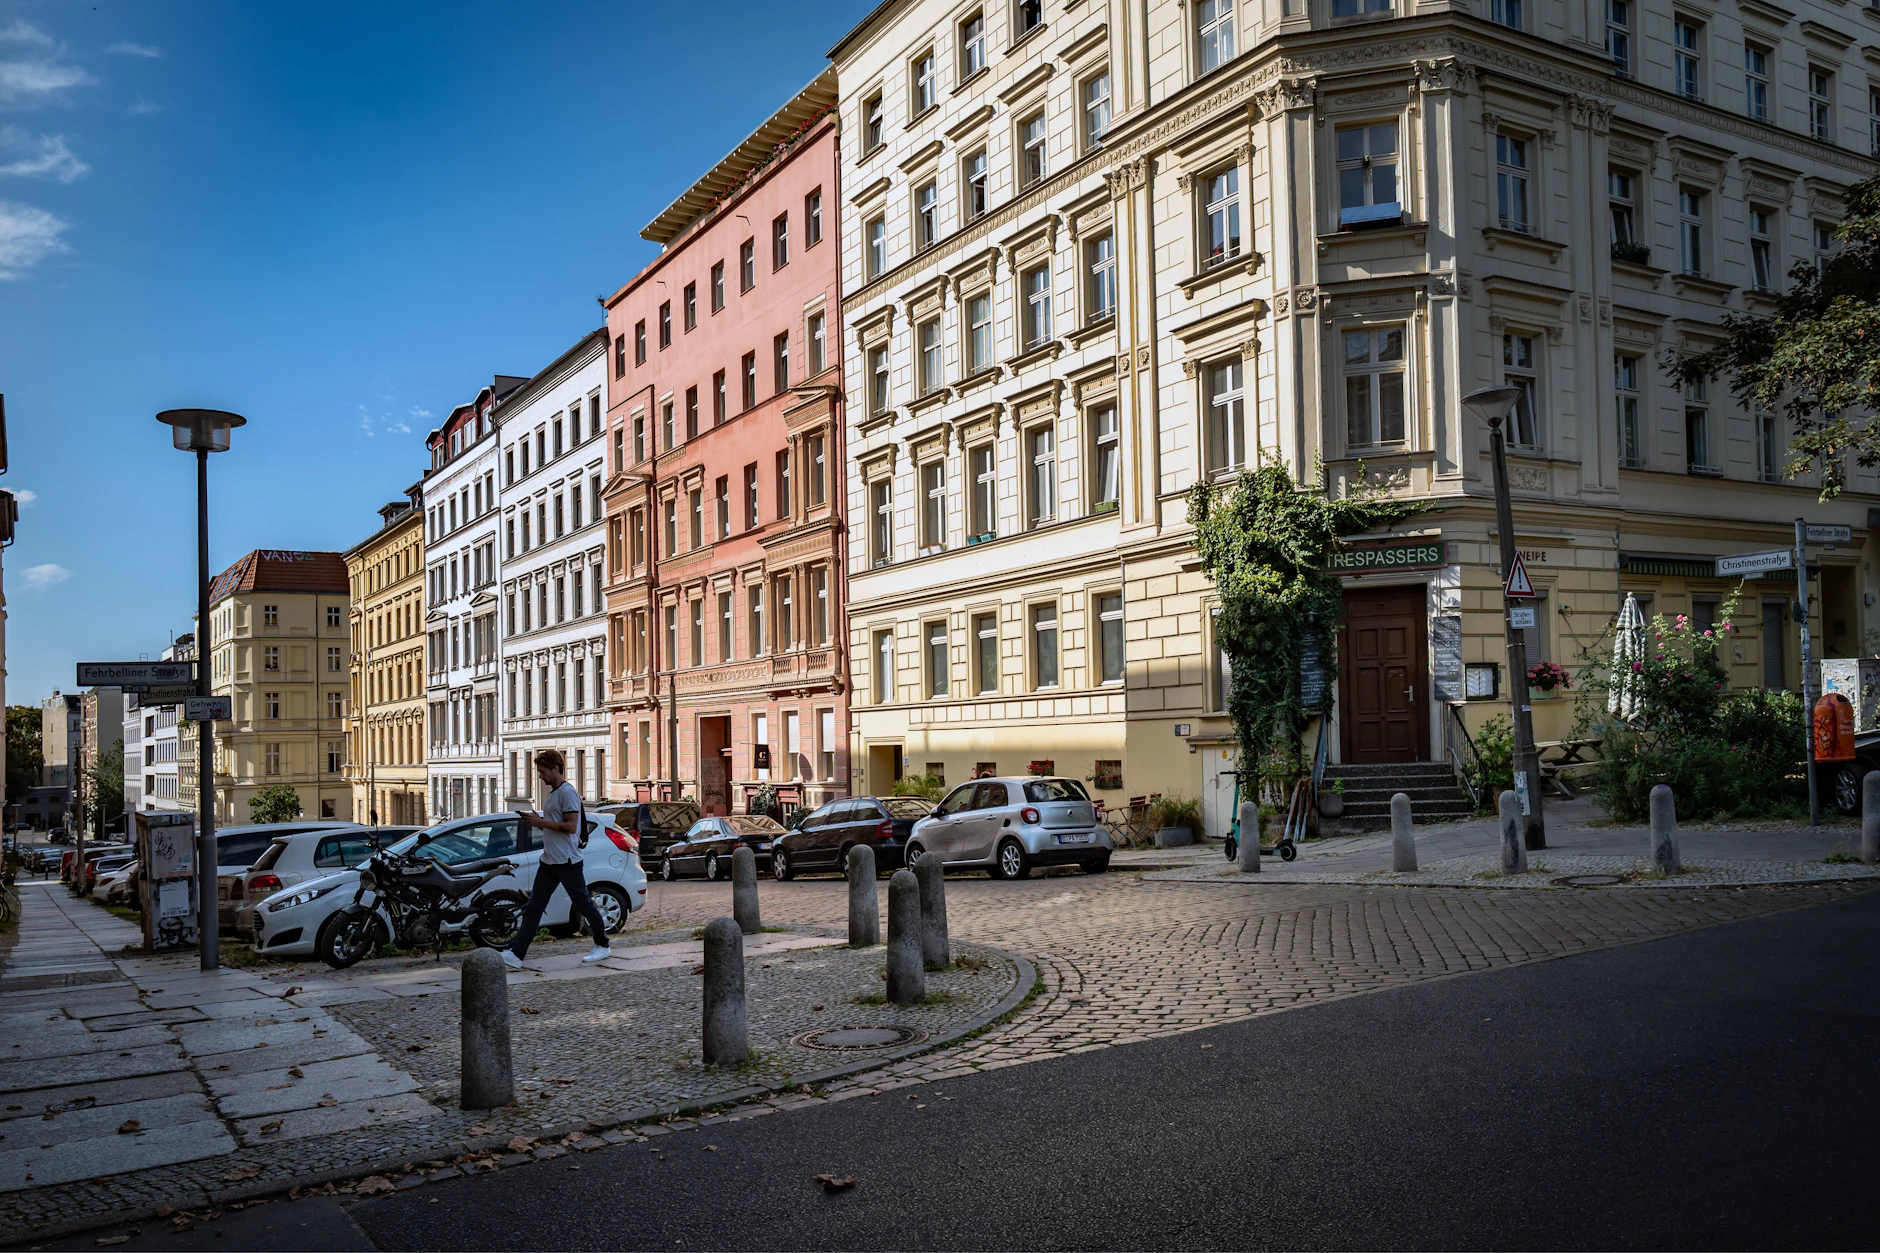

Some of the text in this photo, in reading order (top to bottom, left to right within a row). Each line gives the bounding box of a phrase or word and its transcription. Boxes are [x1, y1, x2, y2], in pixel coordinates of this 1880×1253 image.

[1807, 527, 1849, 539] Fehrbelliner Straße
[1327, 547, 1439, 568] TRESPASSERS
[1519, 551, 1547, 562] NEIPE
[1721, 555, 1787, 570] Christinenstraße
[85, 666, 186, 679] Fehrbelliner Straße
[142, 687, 196, 700] Christinenstraße
